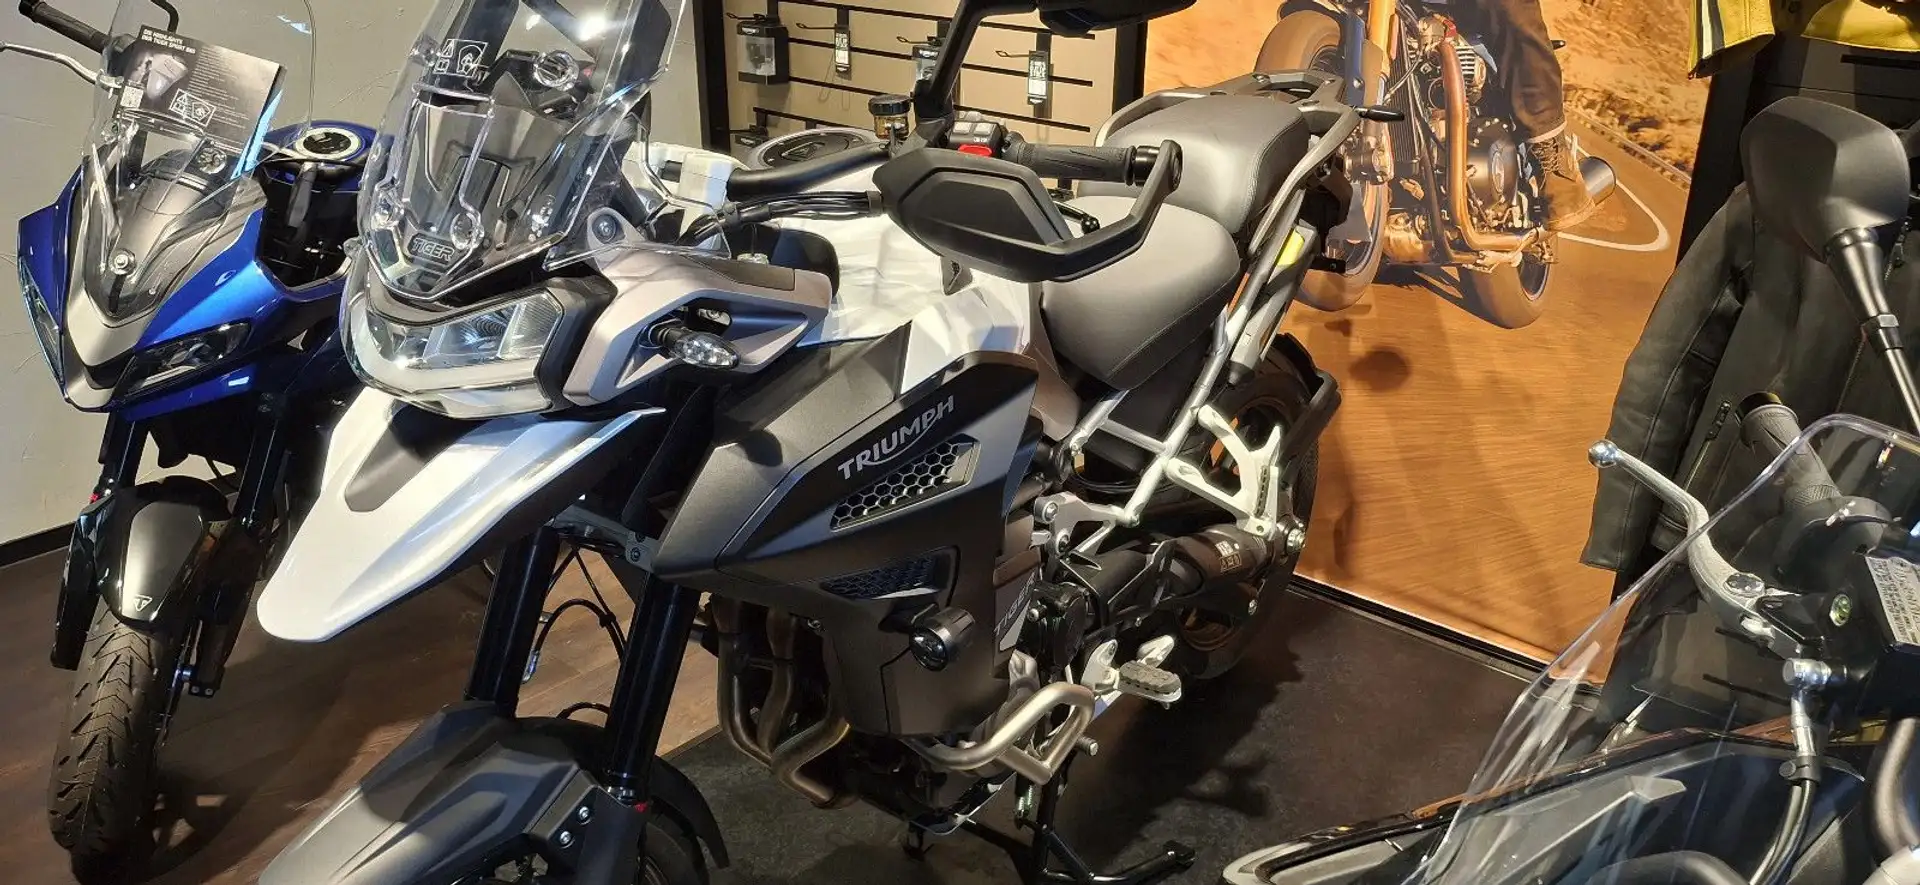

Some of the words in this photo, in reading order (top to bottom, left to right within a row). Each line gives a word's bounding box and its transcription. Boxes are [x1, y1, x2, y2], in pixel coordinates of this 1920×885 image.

[168, 42, 186, 51] SPORT
[413, 238, 455, 261] TIGER
[837, 395, 954, 480] TRIUMPH
[993, 571, 1035, 636] TIGER
